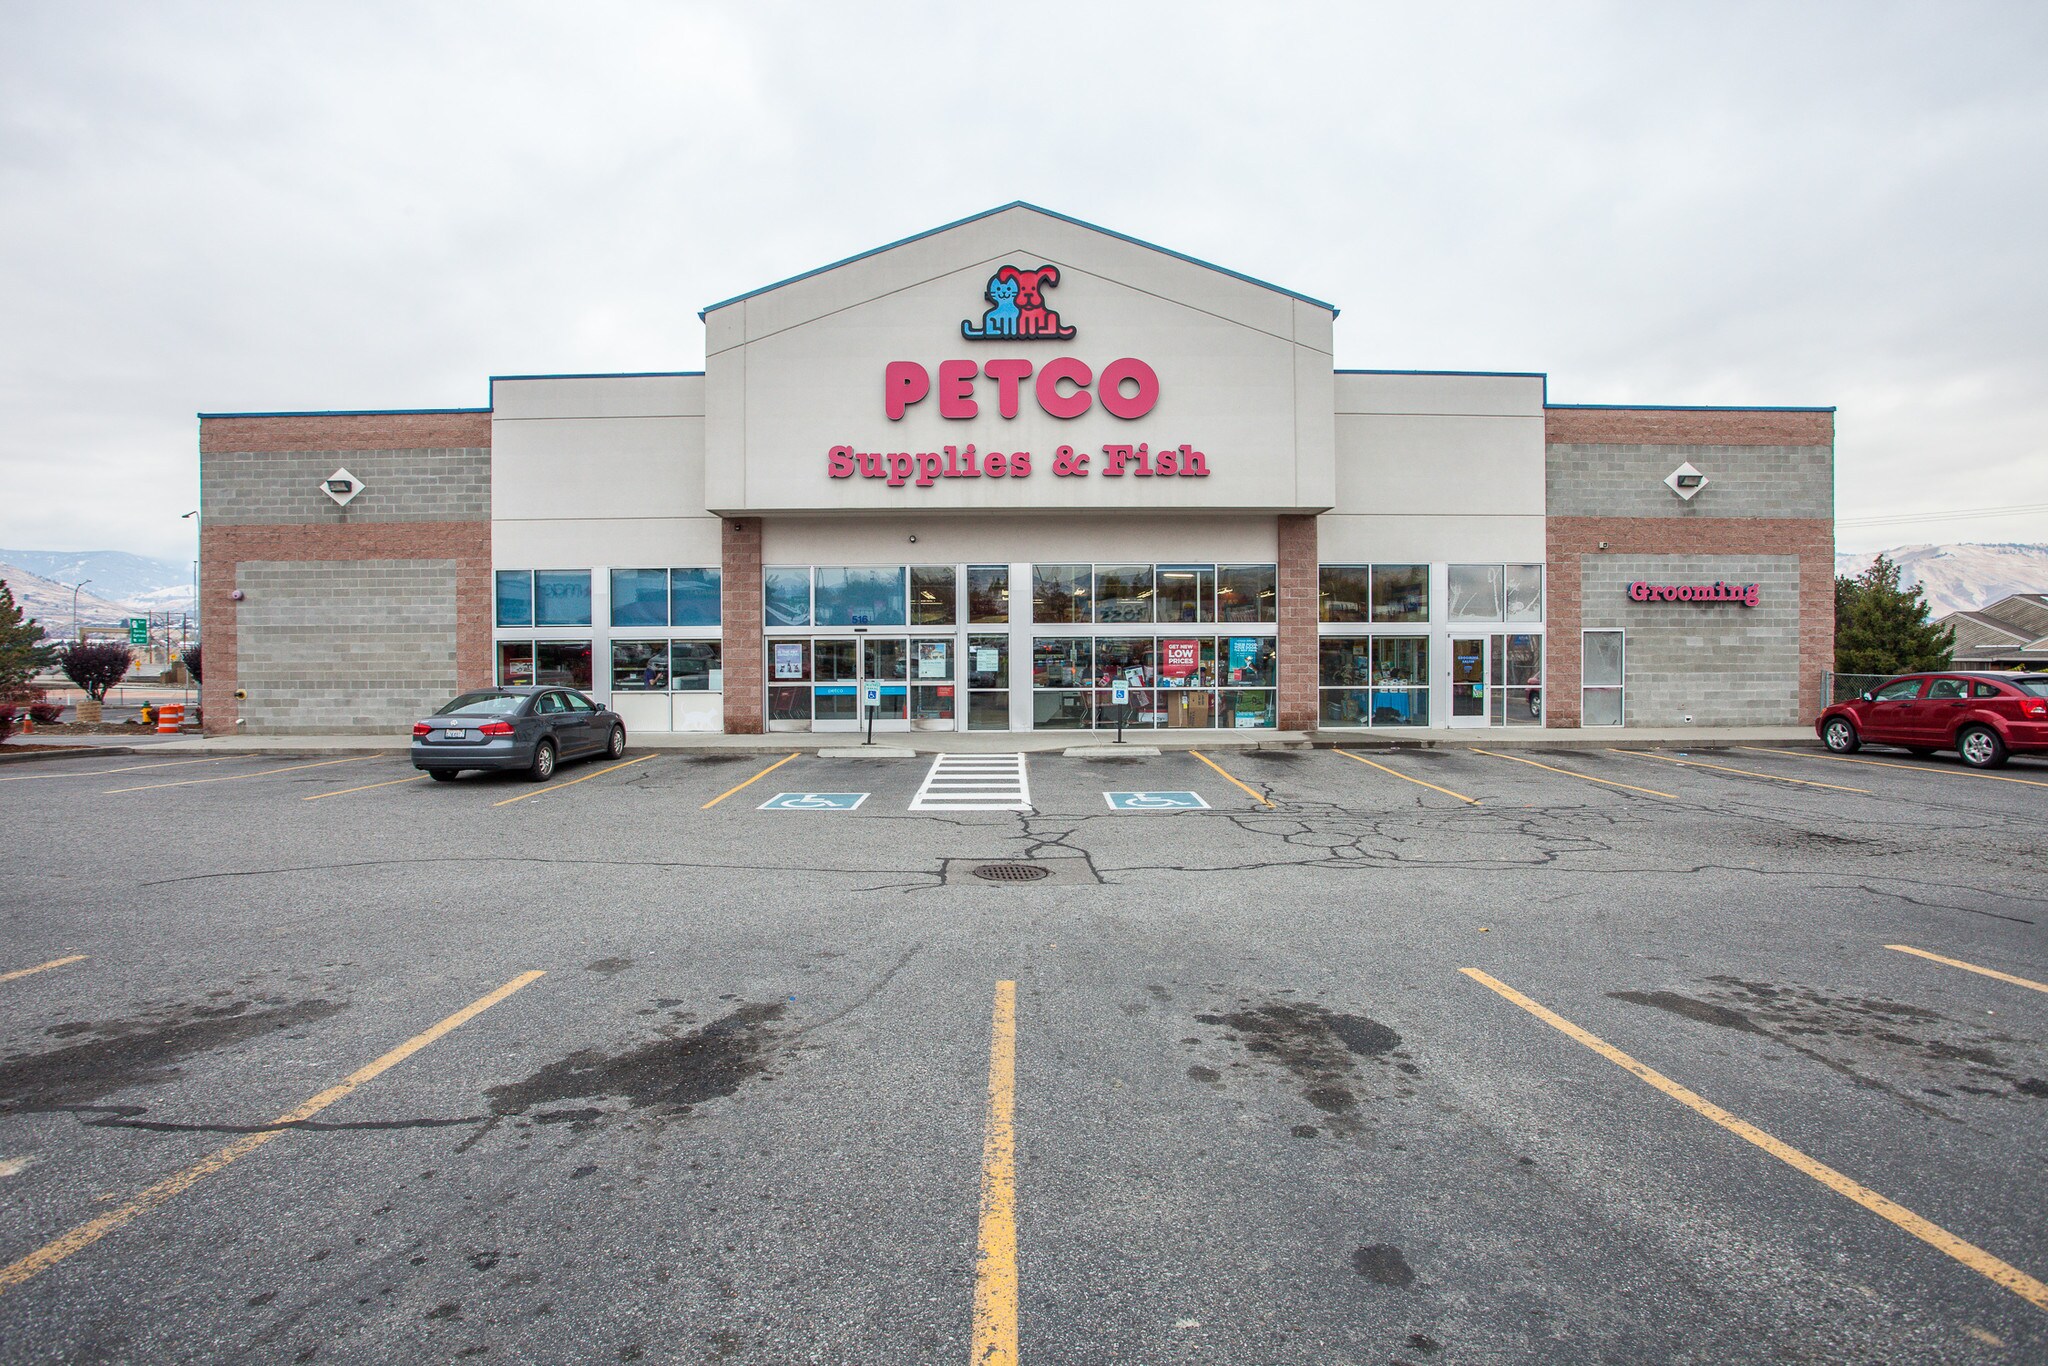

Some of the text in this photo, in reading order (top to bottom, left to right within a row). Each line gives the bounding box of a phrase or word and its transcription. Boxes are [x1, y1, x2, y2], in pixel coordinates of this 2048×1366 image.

[885, 356, 1160, 421] PETCO
[828, 442, 1211, 487] Supplies & Fish
[1628, 580, 1760, 607] Grooming
[852, 615, 869, 624] 516
[1168, 649, 1194, 658] LOW
